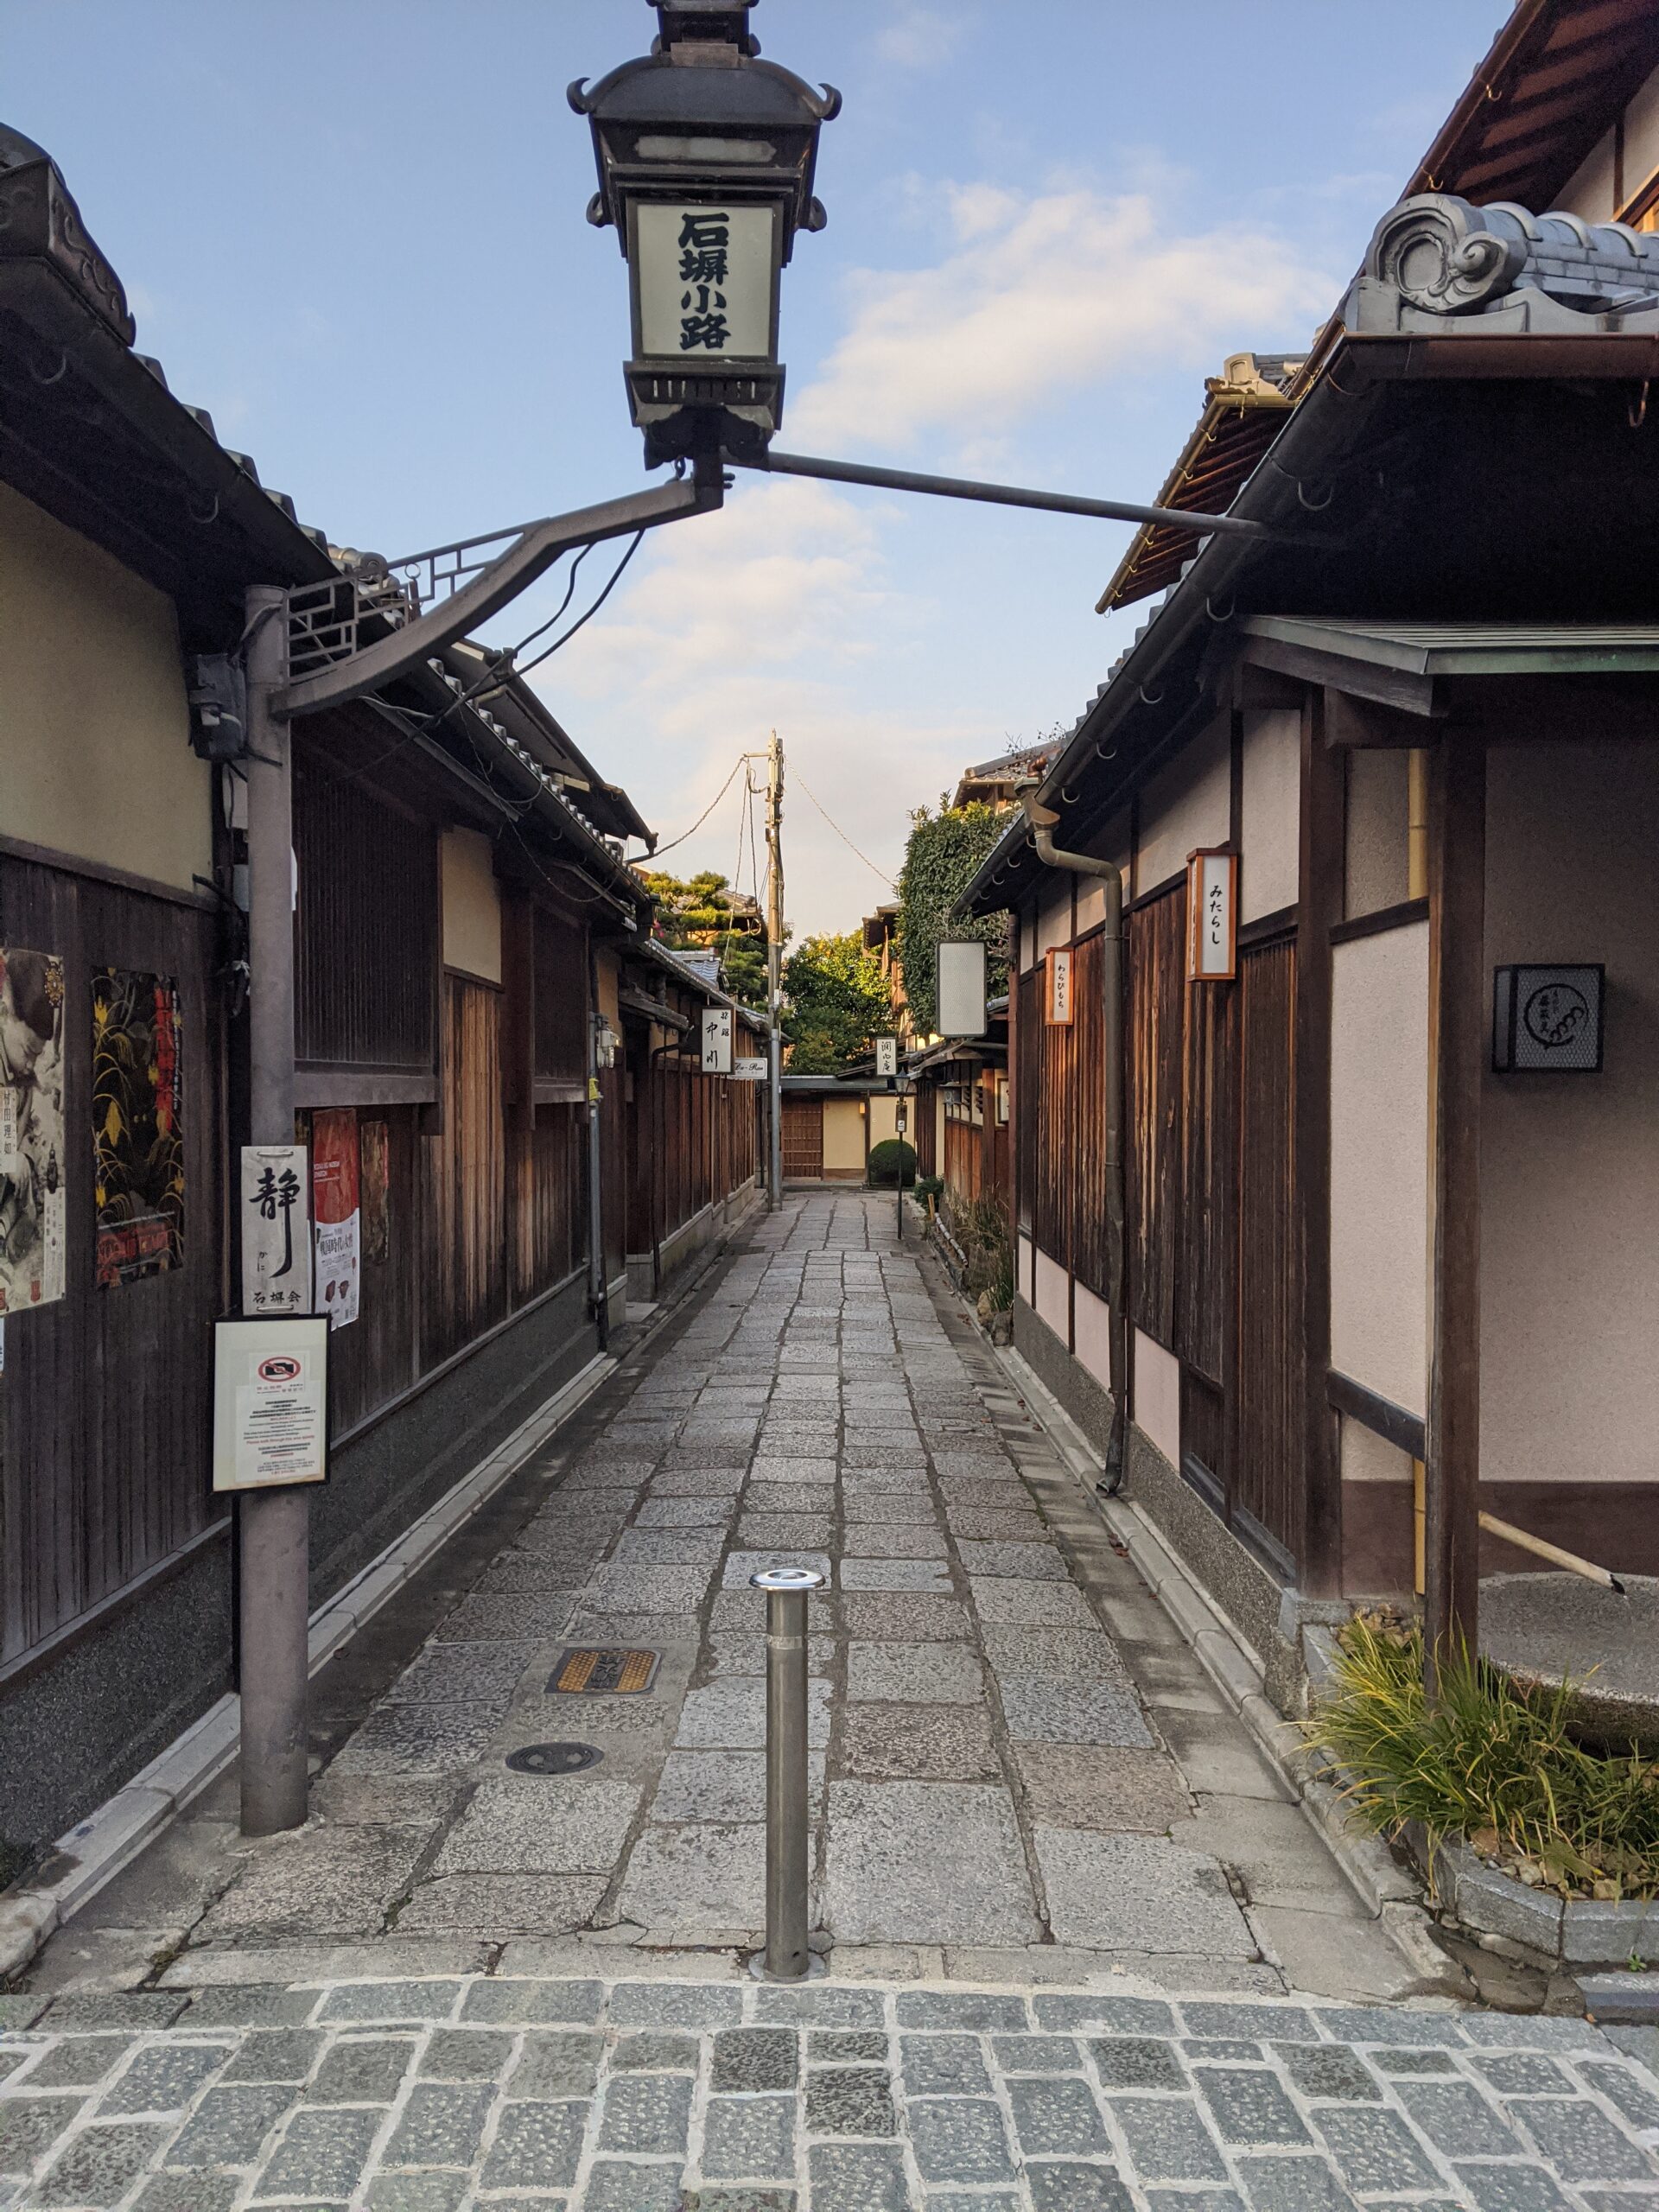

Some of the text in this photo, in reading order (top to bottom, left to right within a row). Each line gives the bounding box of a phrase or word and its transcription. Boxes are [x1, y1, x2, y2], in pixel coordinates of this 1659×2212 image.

[678, 213, 731, 350] 石塀小路
[1210, 885, 1223, 944] みたらし
[1057, 964, 1065, 1008] わらびもち
[705, 1021, 718, 1070] 中川
